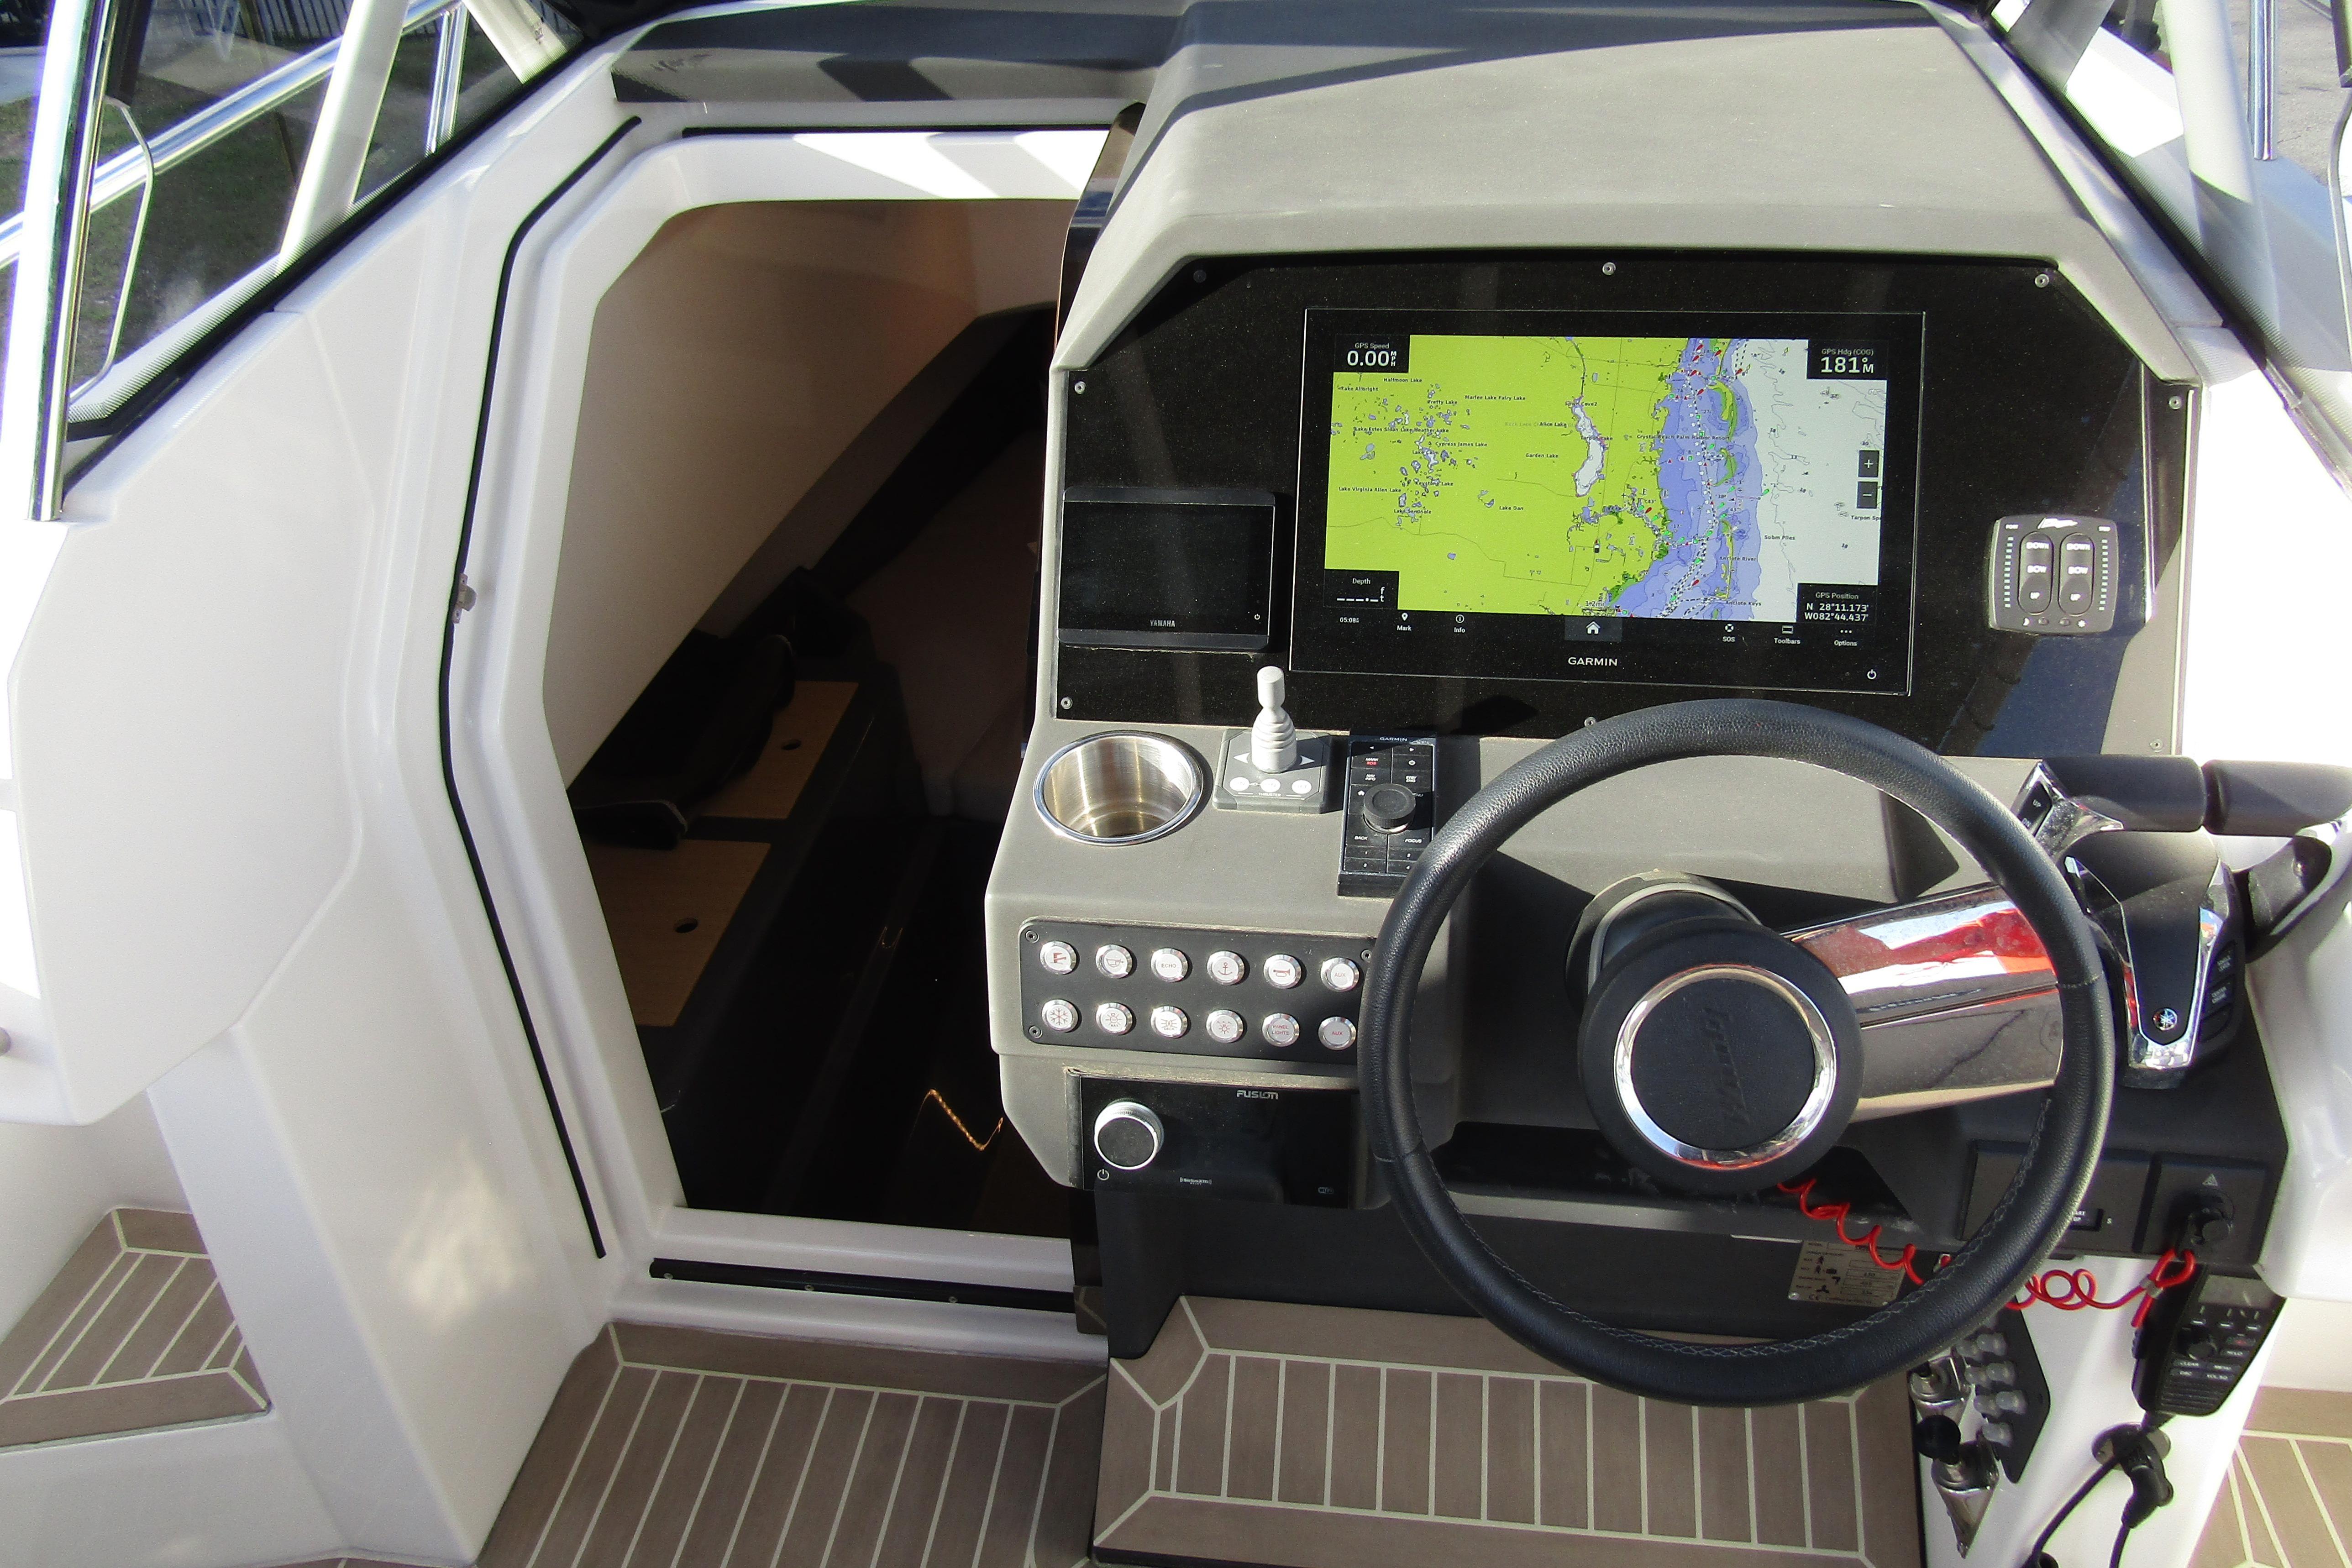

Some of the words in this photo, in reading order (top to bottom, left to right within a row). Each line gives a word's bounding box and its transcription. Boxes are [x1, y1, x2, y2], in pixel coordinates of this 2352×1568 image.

[1347, 350, 1389, 366] 0.00
[2027, 565, 2047, 573] BOW
[2068, 566, 2089, 574] BOW
[1568, 657, 1617, 666] GARMIN
